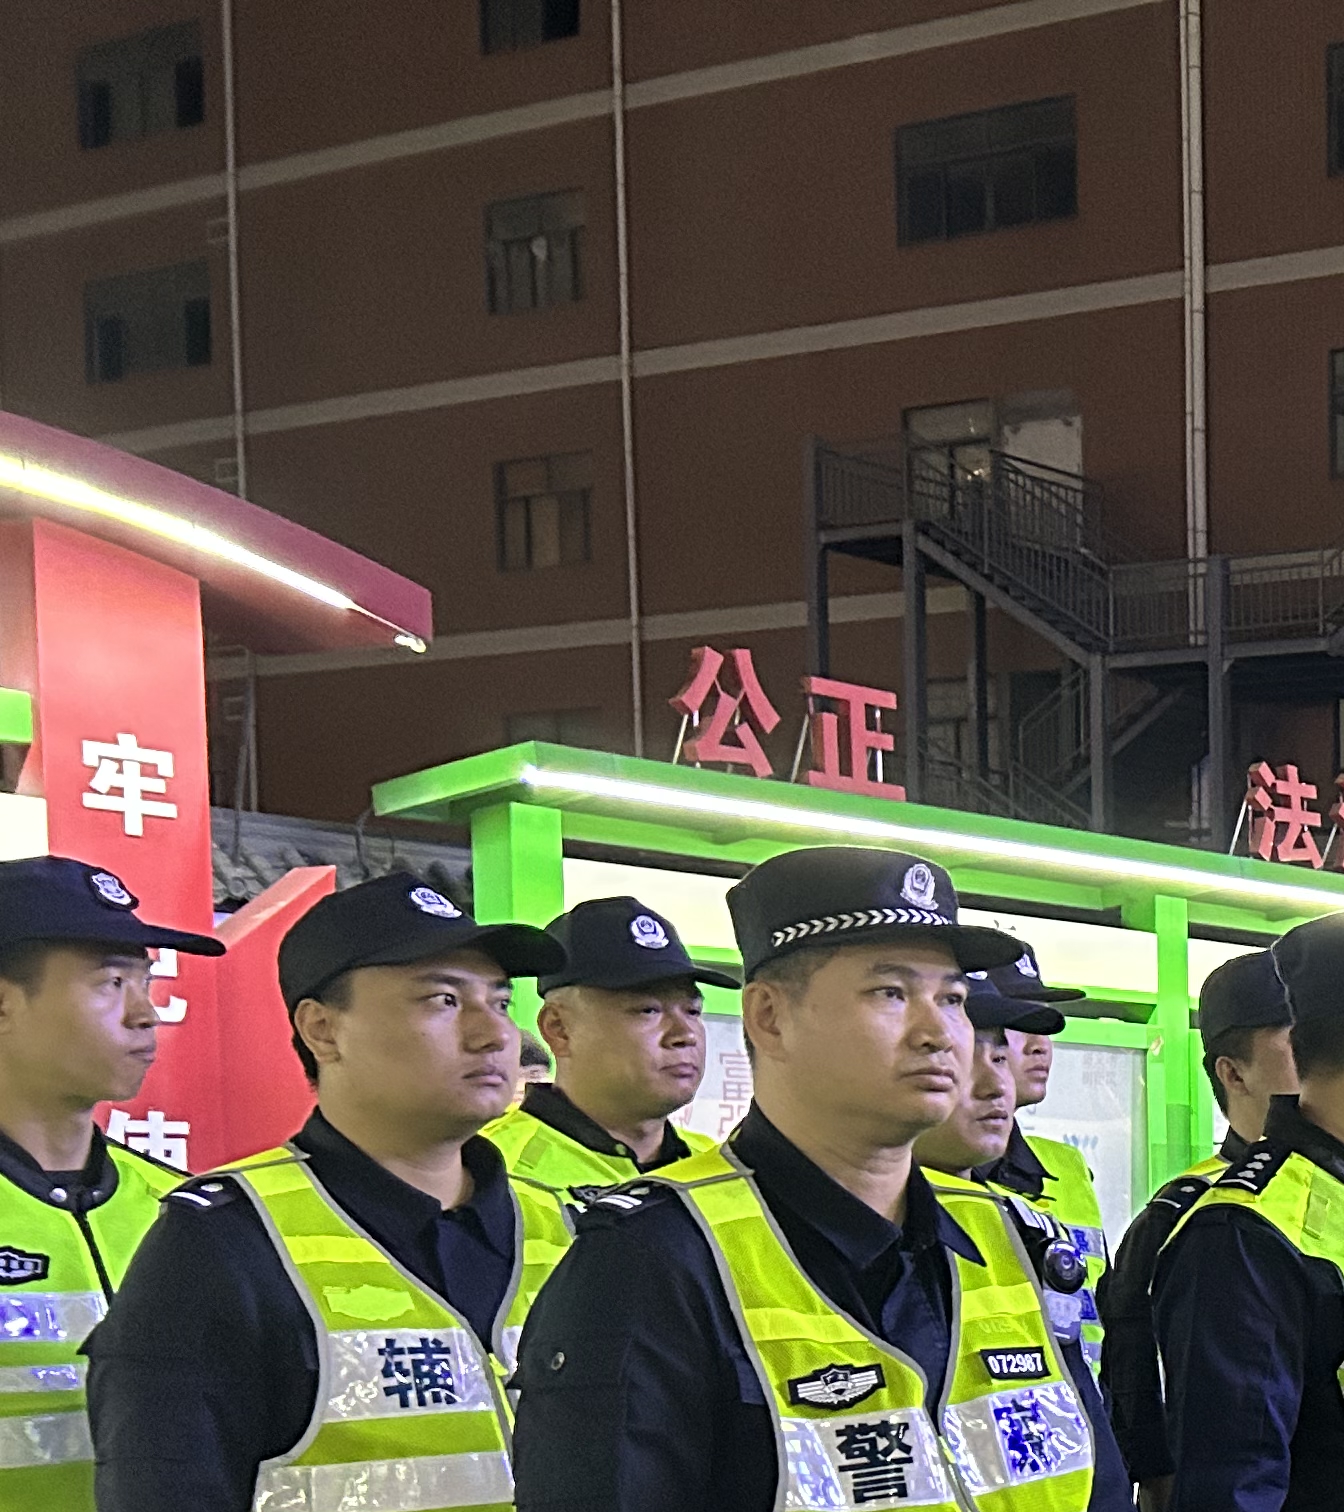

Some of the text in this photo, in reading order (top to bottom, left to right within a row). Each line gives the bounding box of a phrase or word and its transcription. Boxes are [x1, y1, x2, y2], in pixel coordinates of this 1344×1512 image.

[669, 646, 906, 802] 公正
[377, 1338, 457, 1408] 辅
[987, 1352, 1043, 1374] 072987
[836, 1420, 914, 1504] 警
